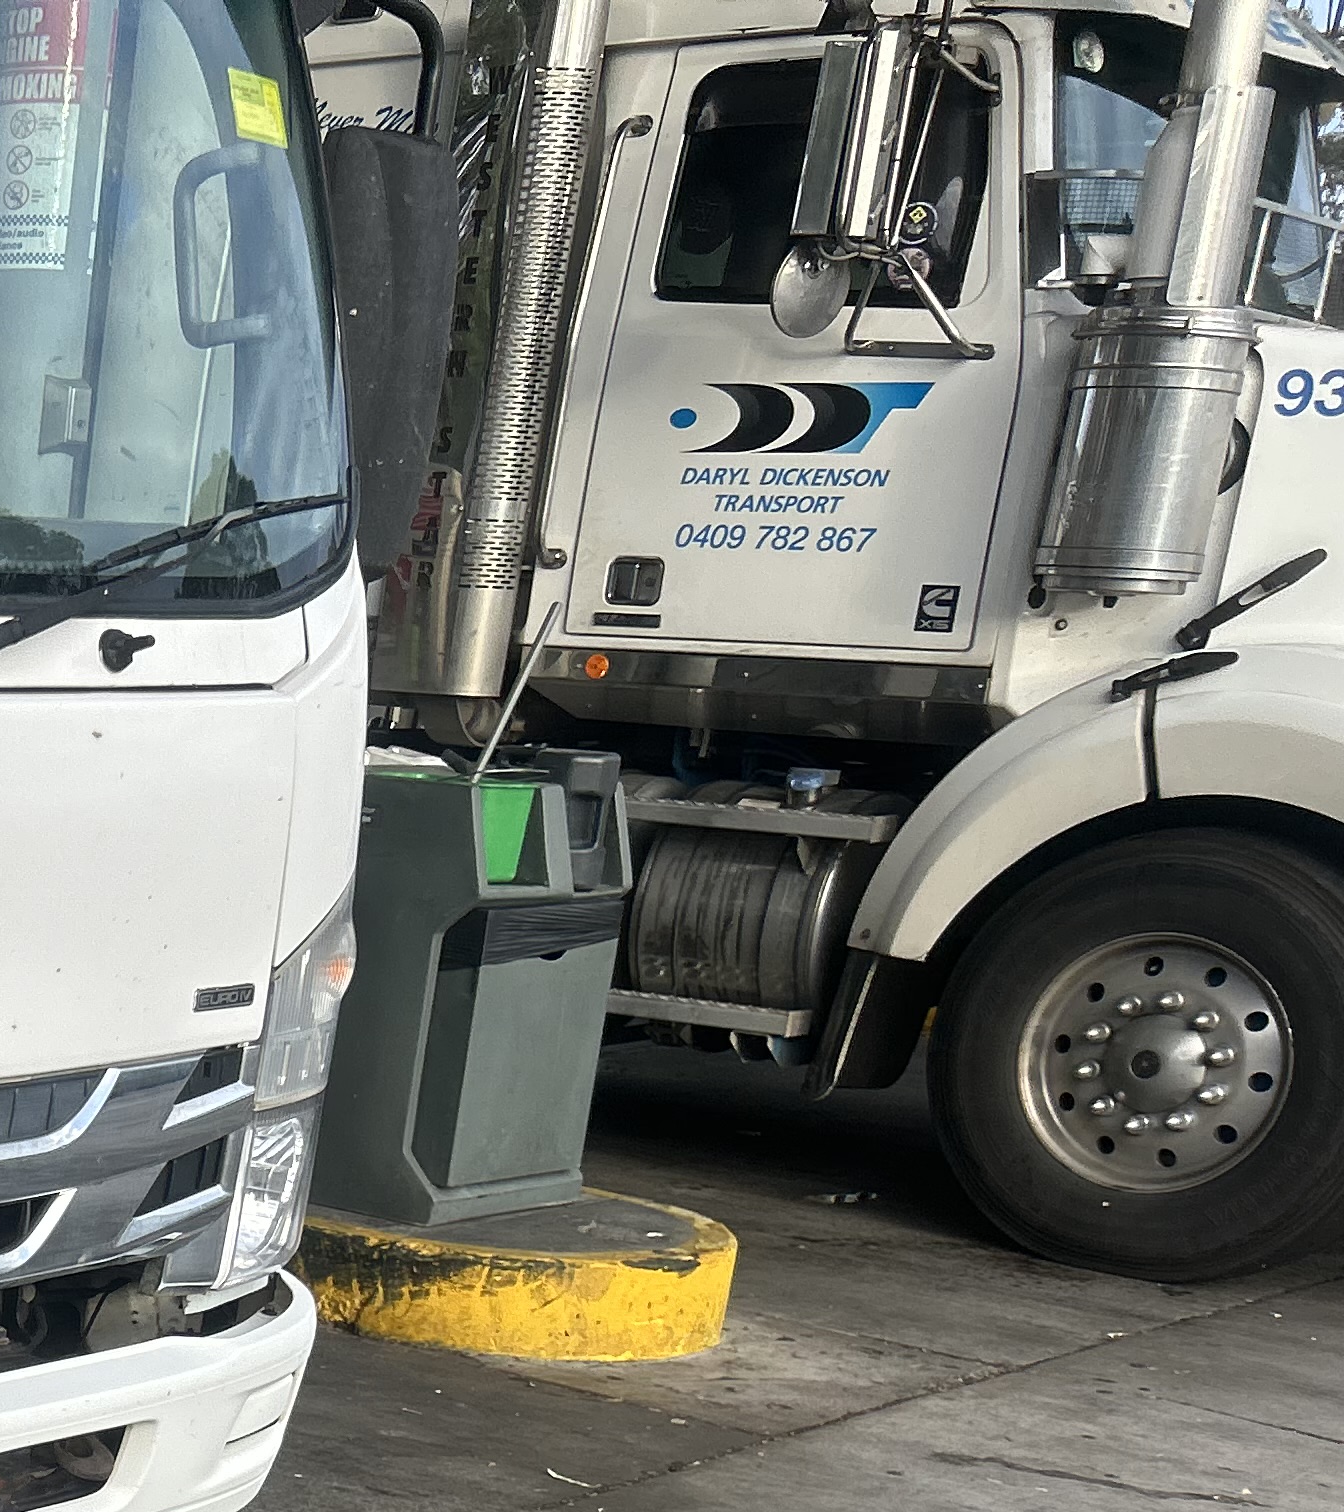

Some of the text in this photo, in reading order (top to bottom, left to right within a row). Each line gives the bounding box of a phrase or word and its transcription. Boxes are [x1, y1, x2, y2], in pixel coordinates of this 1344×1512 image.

[0, 7, 44, 36] TOP
[1274, 368, 1344, 417] 93
[680, 467, 891, 488] DARYL DICKENSON
[713, 494, 845, 514] TRANSPORT
[675, 523, 878, 553] 0409 782 867
